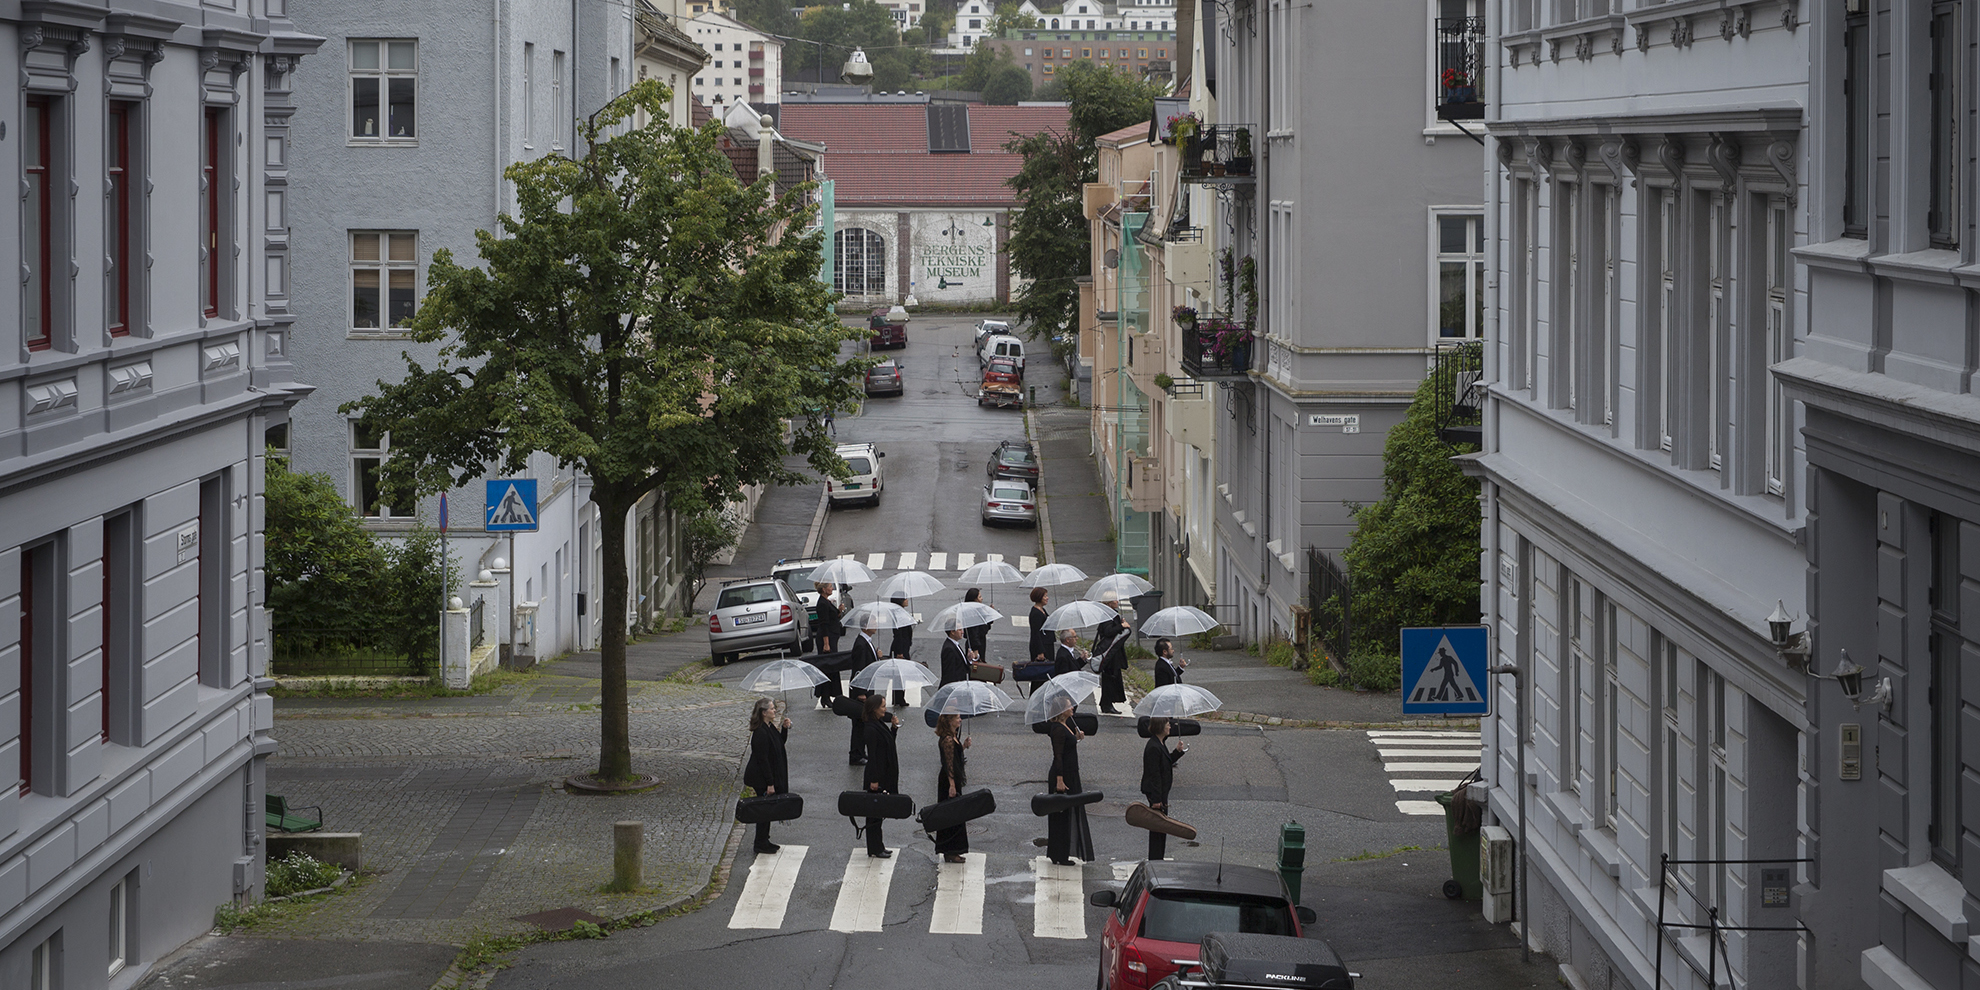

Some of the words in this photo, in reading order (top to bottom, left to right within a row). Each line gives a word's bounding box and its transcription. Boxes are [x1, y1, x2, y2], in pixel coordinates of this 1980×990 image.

[923, 245, 985, 255] BERGENS
[921, 256, 986, 266] TEKNISKE
[927, 267, 980, 278] MUSEUM
[1344, 416, 1356, 425] gate
[1848, 731, 1852, 741] 1
[1265, 973, 1306, 982] PACKLINE
